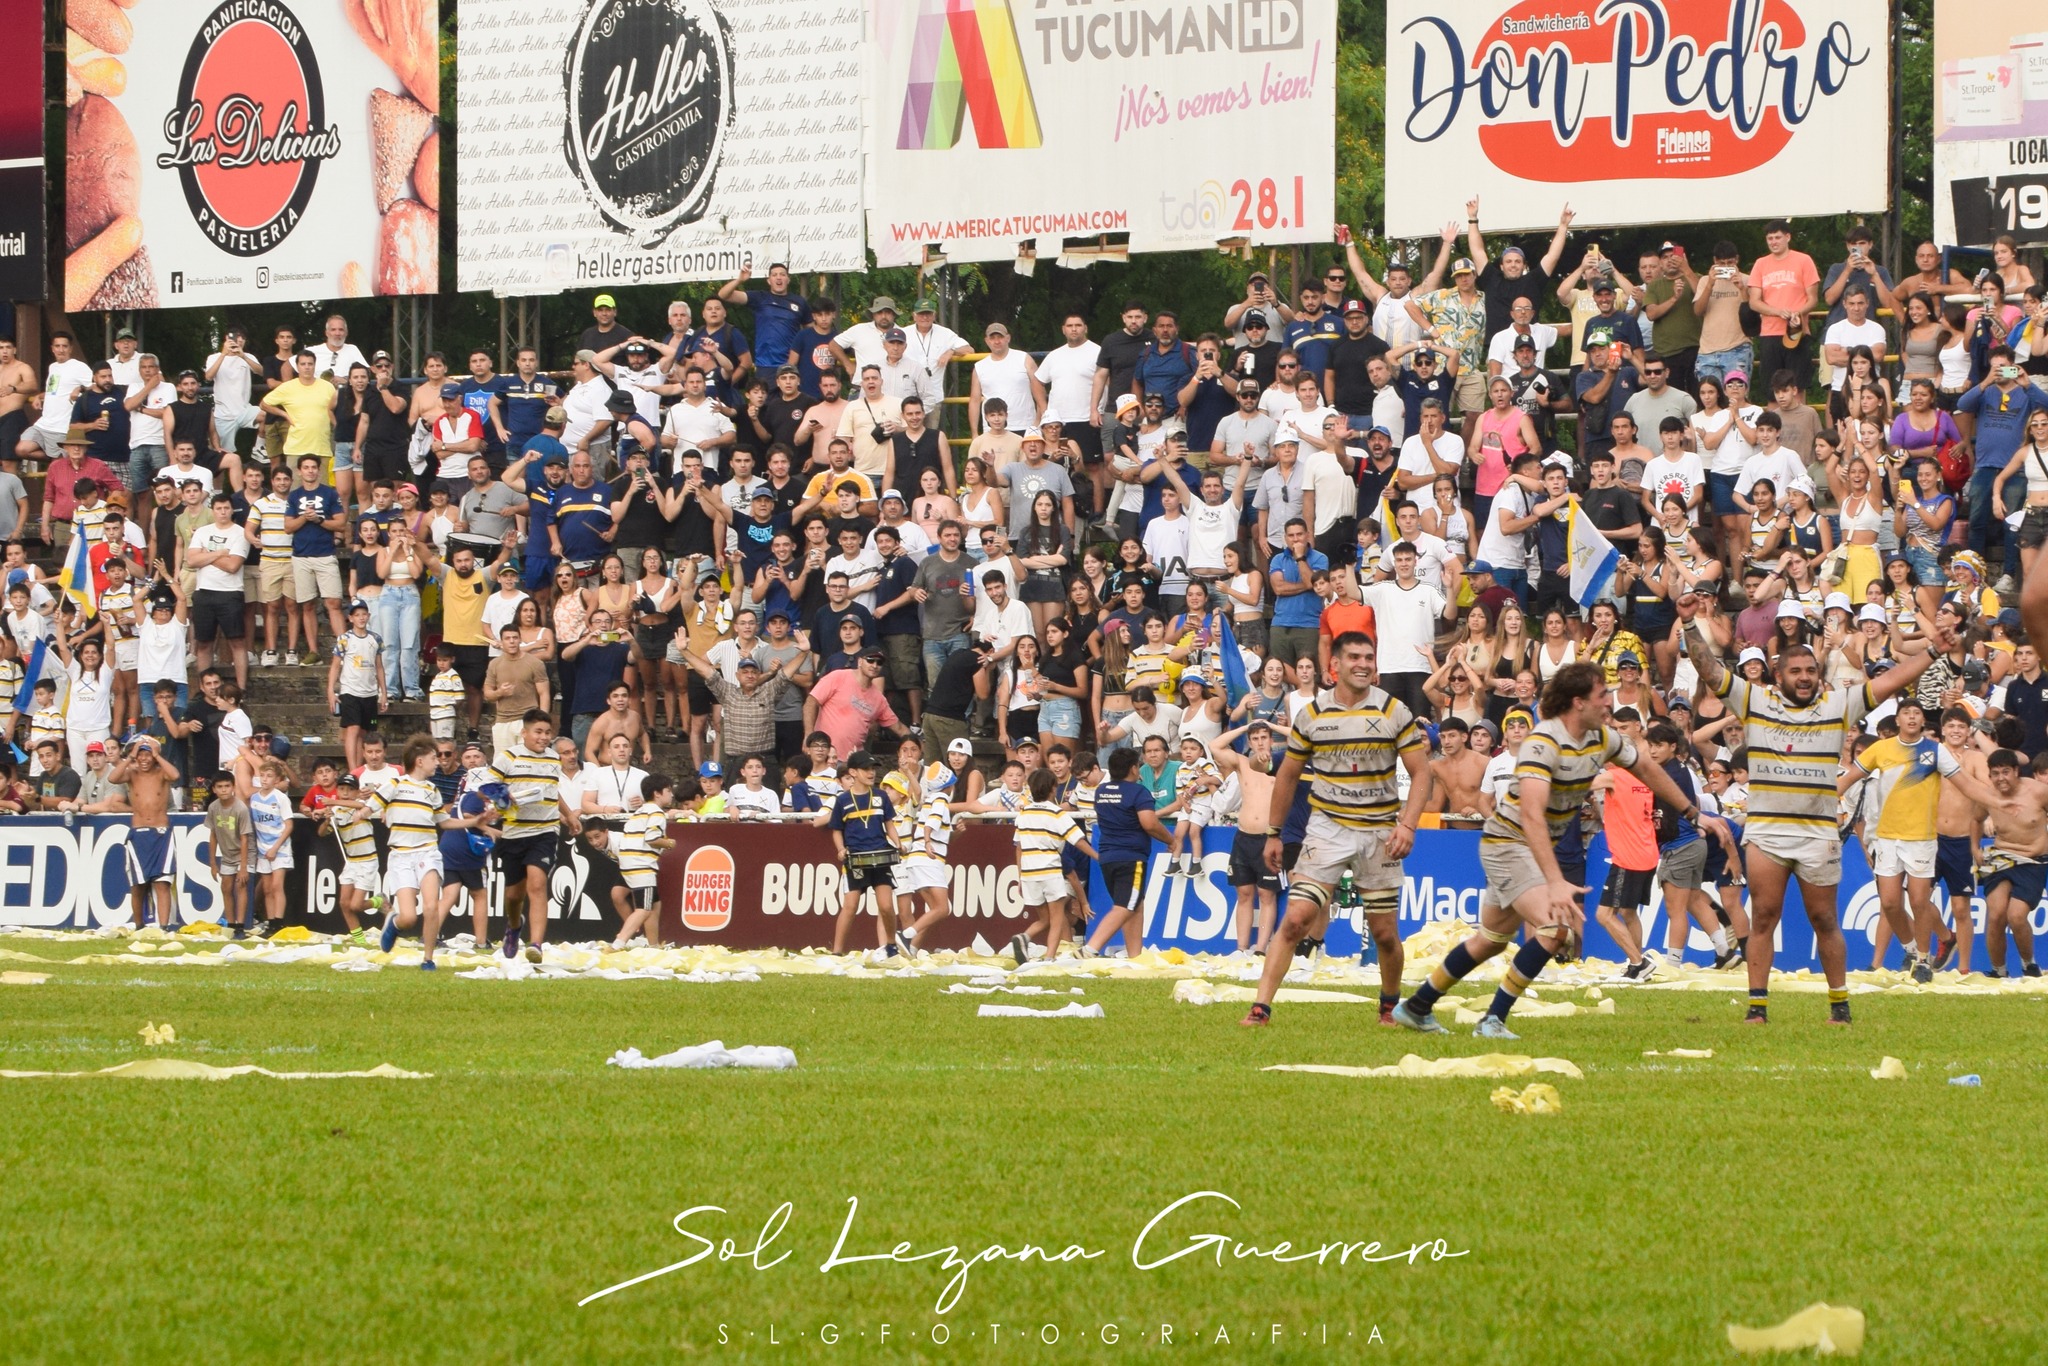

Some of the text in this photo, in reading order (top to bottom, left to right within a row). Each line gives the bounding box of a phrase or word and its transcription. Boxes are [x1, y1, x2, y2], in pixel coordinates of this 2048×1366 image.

[203, 0, 301, 45] PANIFICACION
[1035, 0, 1300, 65] TUCUMAN HD
[1502, 11, 1590, 35] Sandwichería
[1114, 39, 1320, 143] ¡Nos vemos bien!
[1400, 0, 1870, 143] Don Pedro
[586, 33, 712, 161] Heller
[156, 97, 340, 167] Las Delicias
[615, 106, 703, 171] GASTRONOMIA
[1656, 127, 1712, 164] Fidensa
[199, 207, 299, 251] PASTELERIA
[891, 208, 1129, 242] WWW.AMERICATUCUMAN.COM
[576, 243, 754, 284] hellergastronomia
[1757, 764, 1827, 778] LA GACETA
[257, 813, 276, 823] VISA
[306, 855, 346, 915] le
[684, 890, 730, 912] KING
[686, 873, 731, 889] BURGER
